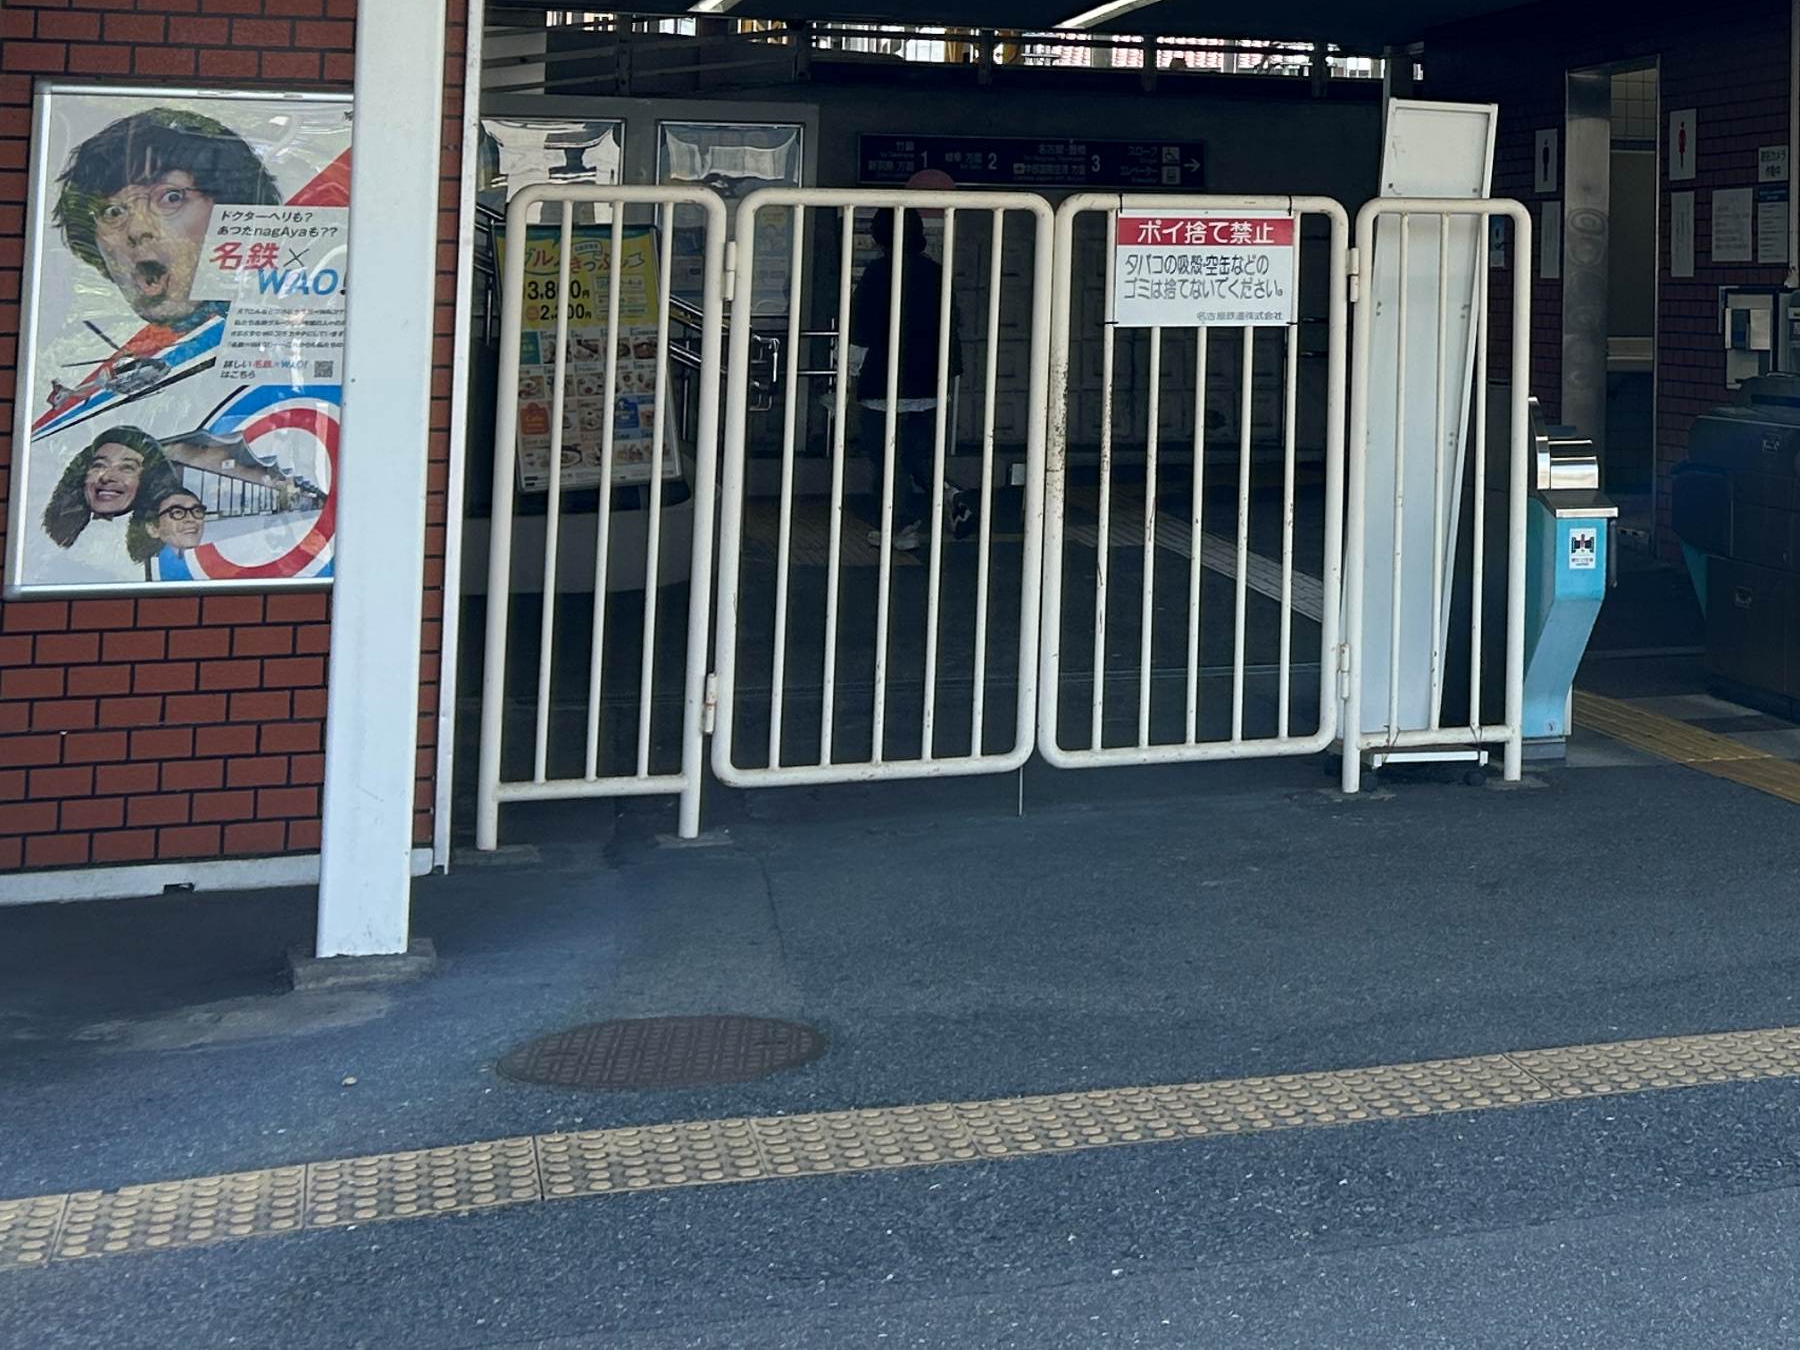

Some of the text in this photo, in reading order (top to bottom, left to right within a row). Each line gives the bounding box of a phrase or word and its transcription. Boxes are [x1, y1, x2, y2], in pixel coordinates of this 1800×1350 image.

[920, 151, 928, 168] 1
[987, 152, 998, 170] 2
[1091, 154, 1101, 172] 3
[1137, 219, 1275, 244] ポイ捨て禁止
[1124, 277, 1284, 300] ゴミは捨てないでください。
